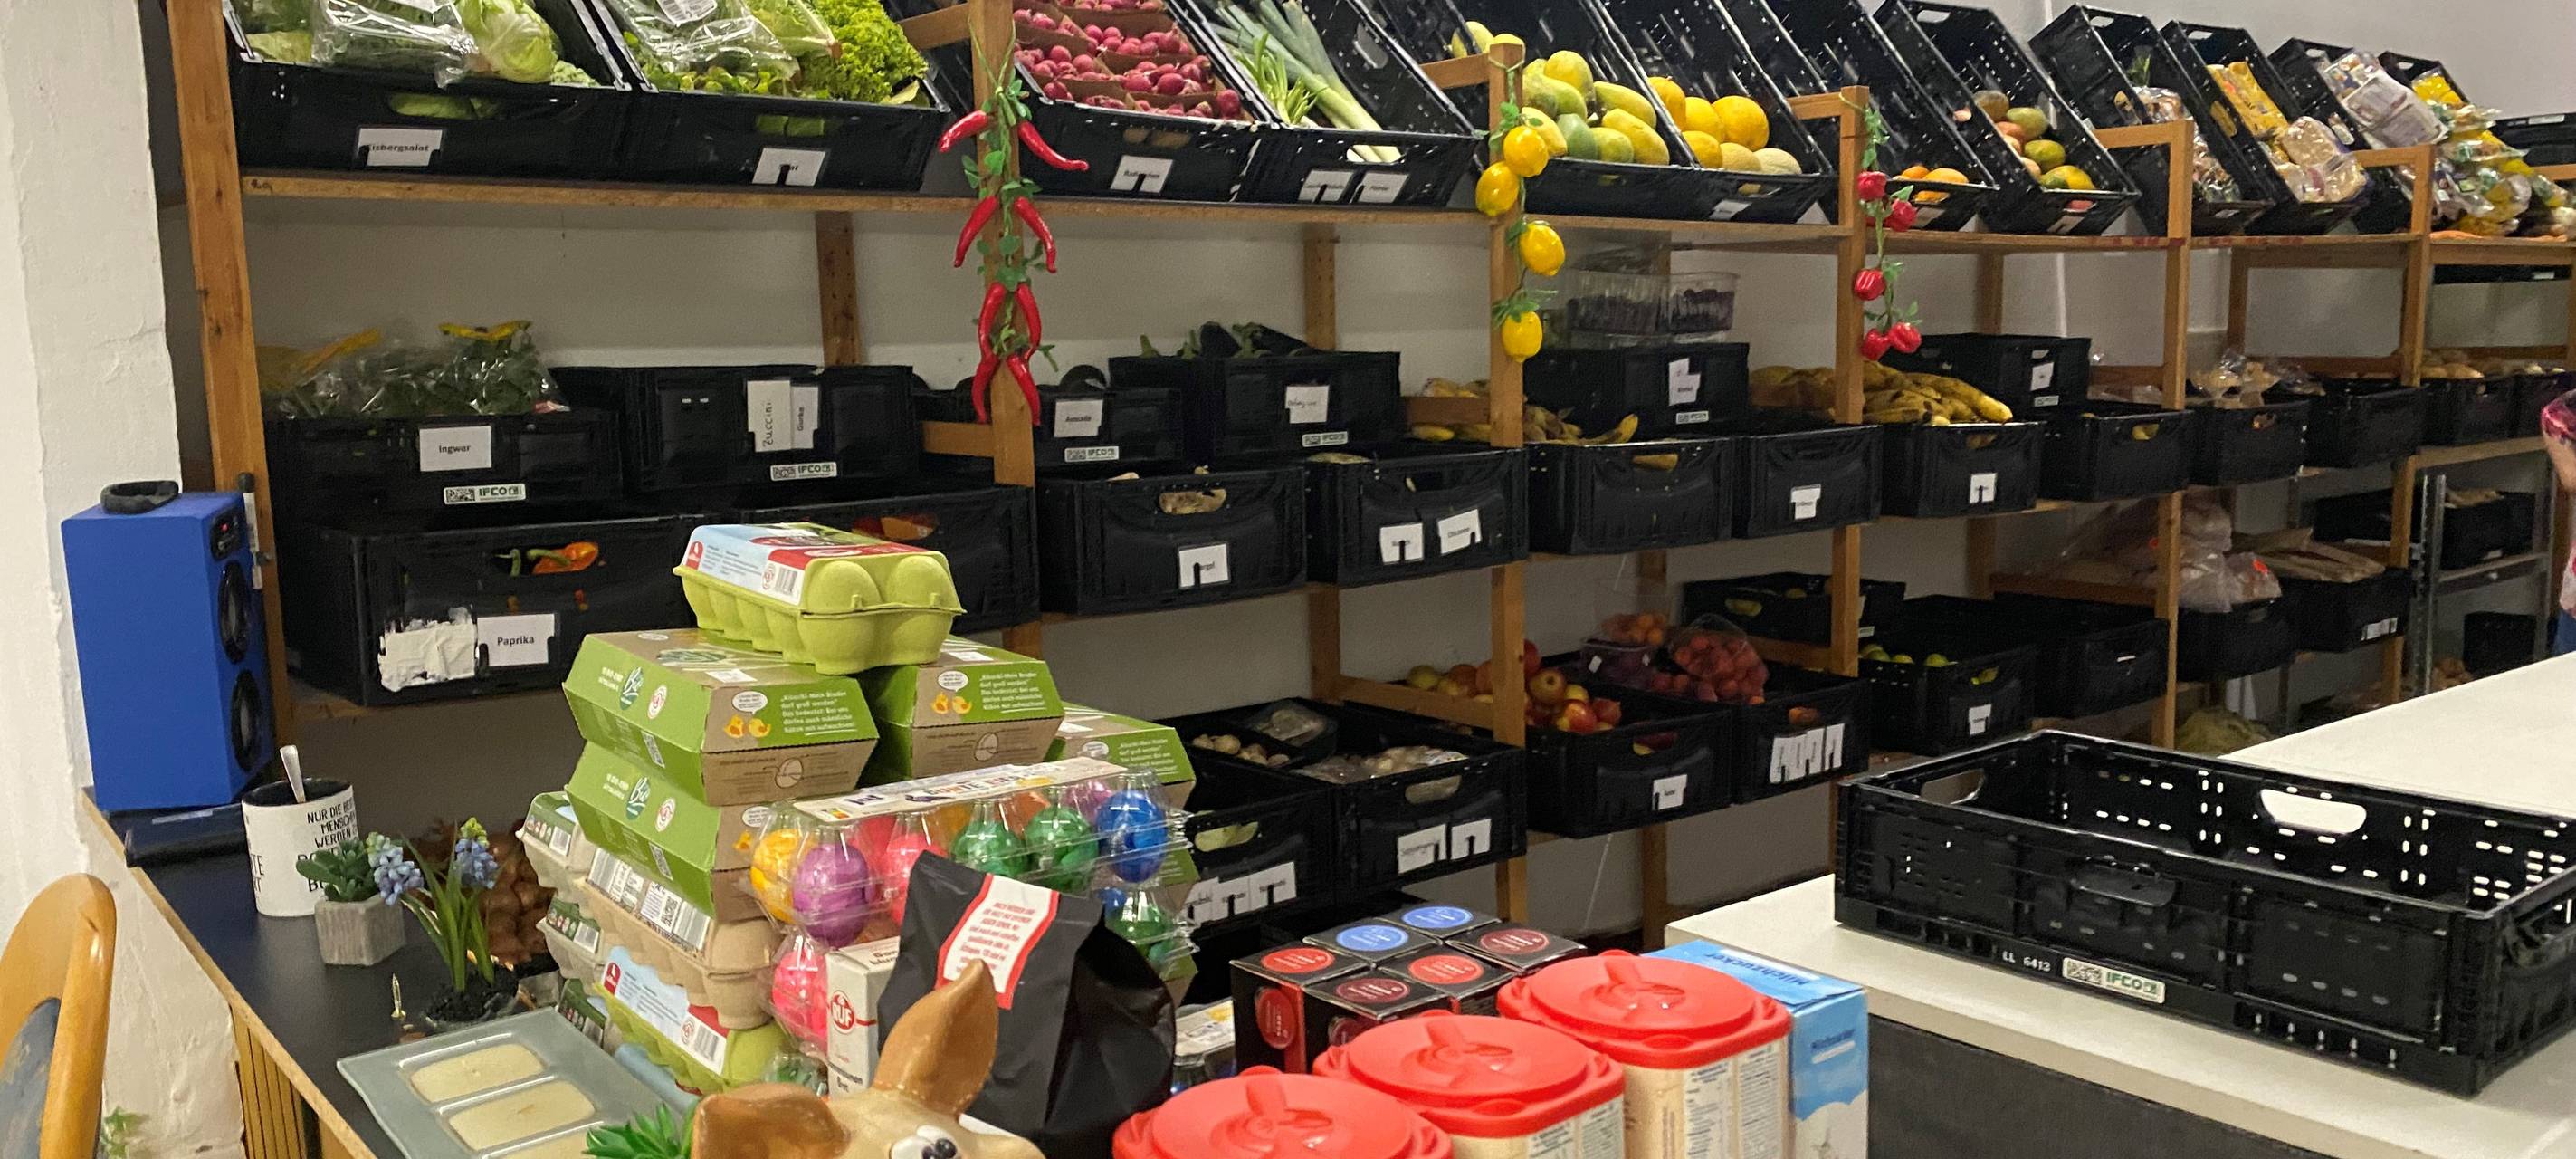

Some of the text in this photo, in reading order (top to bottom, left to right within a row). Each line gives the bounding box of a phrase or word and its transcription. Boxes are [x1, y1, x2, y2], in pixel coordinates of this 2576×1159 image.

[798, 465, 822, 474] IFCO
[479, 486, 507, 497] IFCO
[497, 636, 535, 647] Paprika
[307, 809, 329, 824] NUR
[329, 803, 342, 818] DIE
[314, 828, 351, 848] WERDEN
[1704, 953, 1810, 987] Milchzucker
[2023, 957, 2051, 972] 6413
[2106, 972, 2142, 991] IFCO
[832, 1001, 852, 1030] RUF
